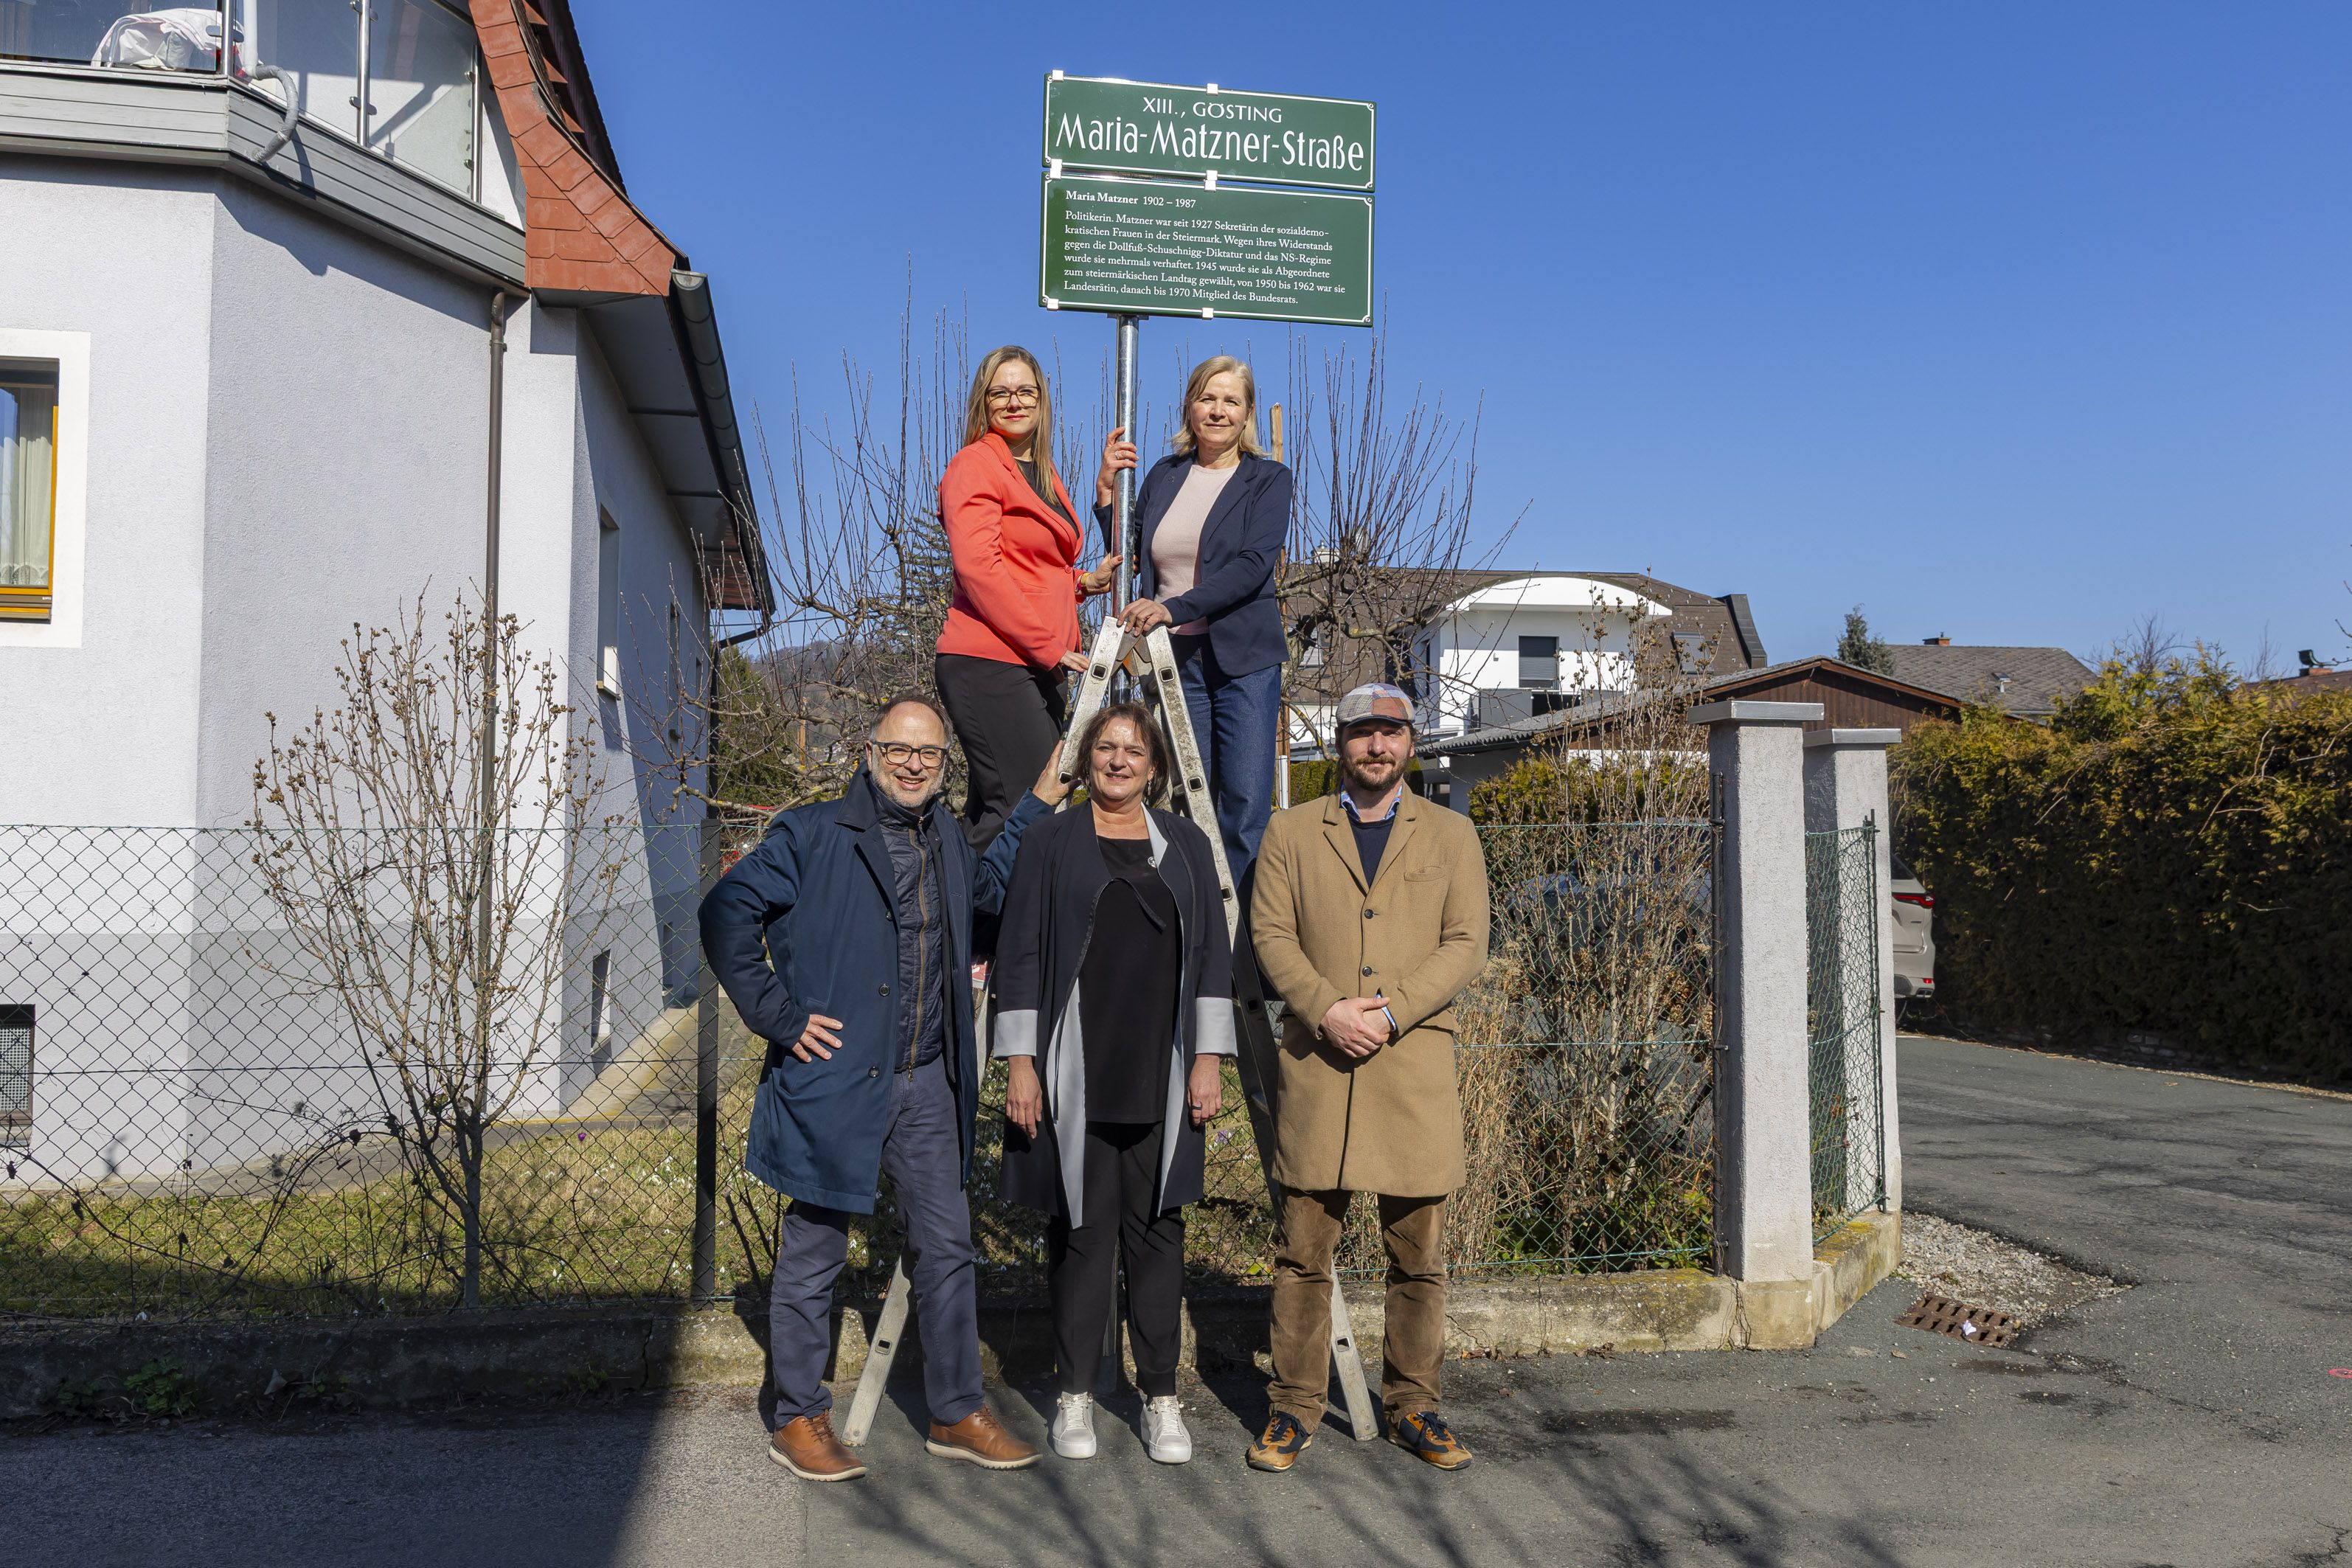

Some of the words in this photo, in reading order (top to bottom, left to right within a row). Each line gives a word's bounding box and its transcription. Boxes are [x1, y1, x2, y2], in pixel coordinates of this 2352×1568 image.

[1142, 97, 1186, 119] XIII.,
[1193, 101, 1282, 123] GÖSTING
[1055, 112, 1364, 171] Maria-Matzner-Straße
[1065, 190, 1096, 201] Maria
[1097, 192, 1139, 204] Matzner
[1143, 196, 1164, 207] 1902
[1175, 198, 1196, 208] 1987
[1065, 210, 1114, 223] Politikerin.
[1115, 213, 1154, 225] Matzner
[1173, 218, 1189, 228] seit
[1191, 219, 1213, 229] 1927
[1215, 220, 1259, 232] Sekretärin
[1260, 223, 1275, 234] der
[1277, 226, 1329, 237] sozialdemo-
[1065, 224, 1110, 236] kratischen
[1112, 227, 1142, 238] Frauen
[1145, 230, 1154, 239] in
[1156, 230, 1170, 240] der
[1173, 231, 1222, 243] Steiermark.
[1223, 235, 1254, 248] Wegen
[1256, 237, 1277, 247] ihres
[1278, 238, 1333, 251] Widerstands
[1064, 241, 1091, 251] gegen
[1092, 240, 1106, 250] die
[1109, 240, 1243, 259] Dollfuß-Schuschnigg-Diktatur
[1245, 251, 1262, 260] und
[1264, 251, 1279, 261] das
[1280, 252, 1332, 266] NS-Regime
[1064, 253, 1092, 263] wurde
[1094, 254, 1106, 264] sie
[1108, 256, 1151, 267] mehrmals
[1152, 259, 1193, 269] verhaftet.
[1196, 261, 1217, 271] 1945
[1218, 263, 1246, 273] wurde
[1248, 265, 1260, 274] sie
[1261, 266, 1273, 274] als
[1274, 266, 1330, 279] Abgeordnete
[1064, 280, 1119, 294] Landesrätin,
[1120, 284, 1151, 295] danach
[1154, 285, 1167, 296] bis
[1169, 287, 1190, 297] 1970
[1192, 288, 1230, 302] Mitglied
[1232, 291, 1246, 301] des
[1249, 291, 1298, 304] Bundesrats.
[1086, 268, 1159, 281] steiermärkischen
[1161, 272, 1198, 286] Landtag
[1198, 276, 1236, 288] gewählt,
[1255, 279, 1277, 288] 1950
[1278, 280, 1291, 290] bis
[1294, 281, 1314, 291] 1962
[1333, 285, 1345, 294] sie
